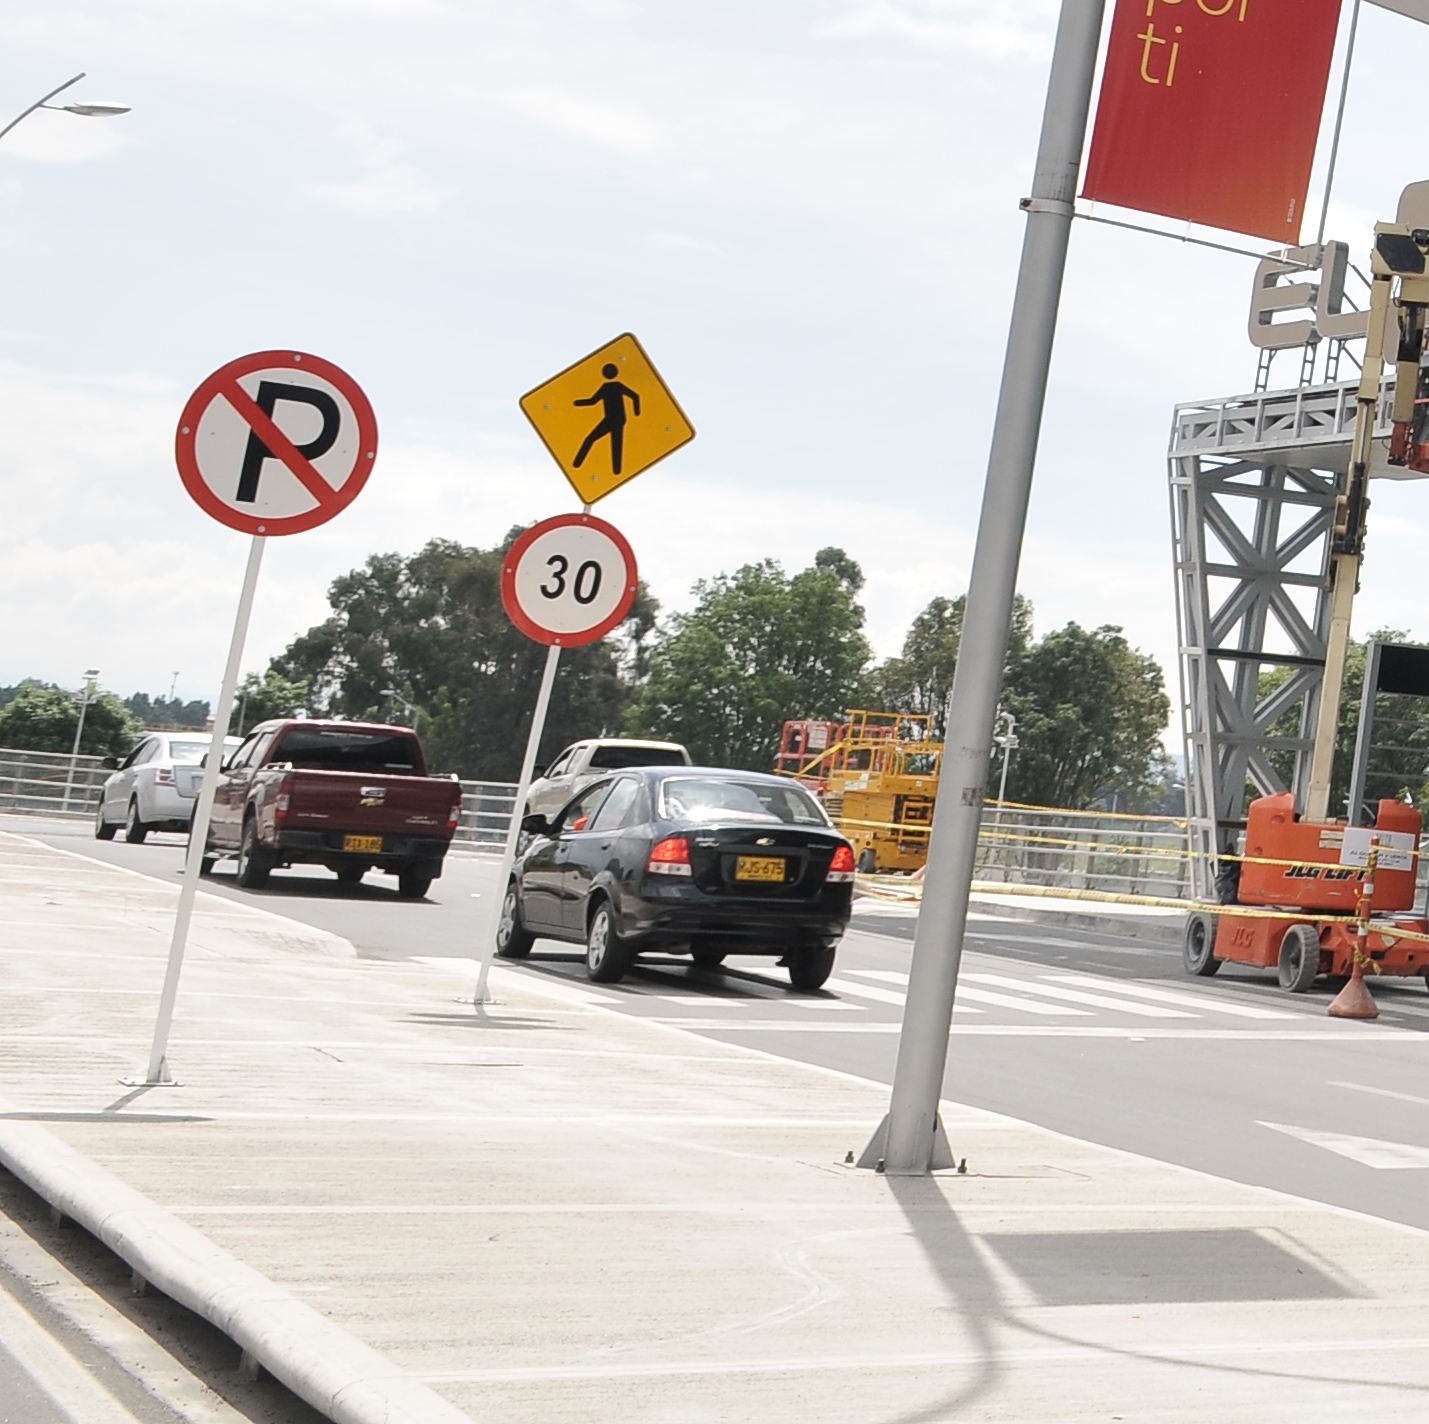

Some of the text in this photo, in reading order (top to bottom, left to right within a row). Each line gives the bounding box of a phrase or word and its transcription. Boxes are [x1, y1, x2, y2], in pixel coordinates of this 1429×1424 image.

[1137, 23, 1183, 87] ti
[1248, 239, 1374, 349] EL
[540, 554, 602, 604] 30
[1283, 865, 1320, 879] JLG
[1231, 927, 1255, 947] JLG
